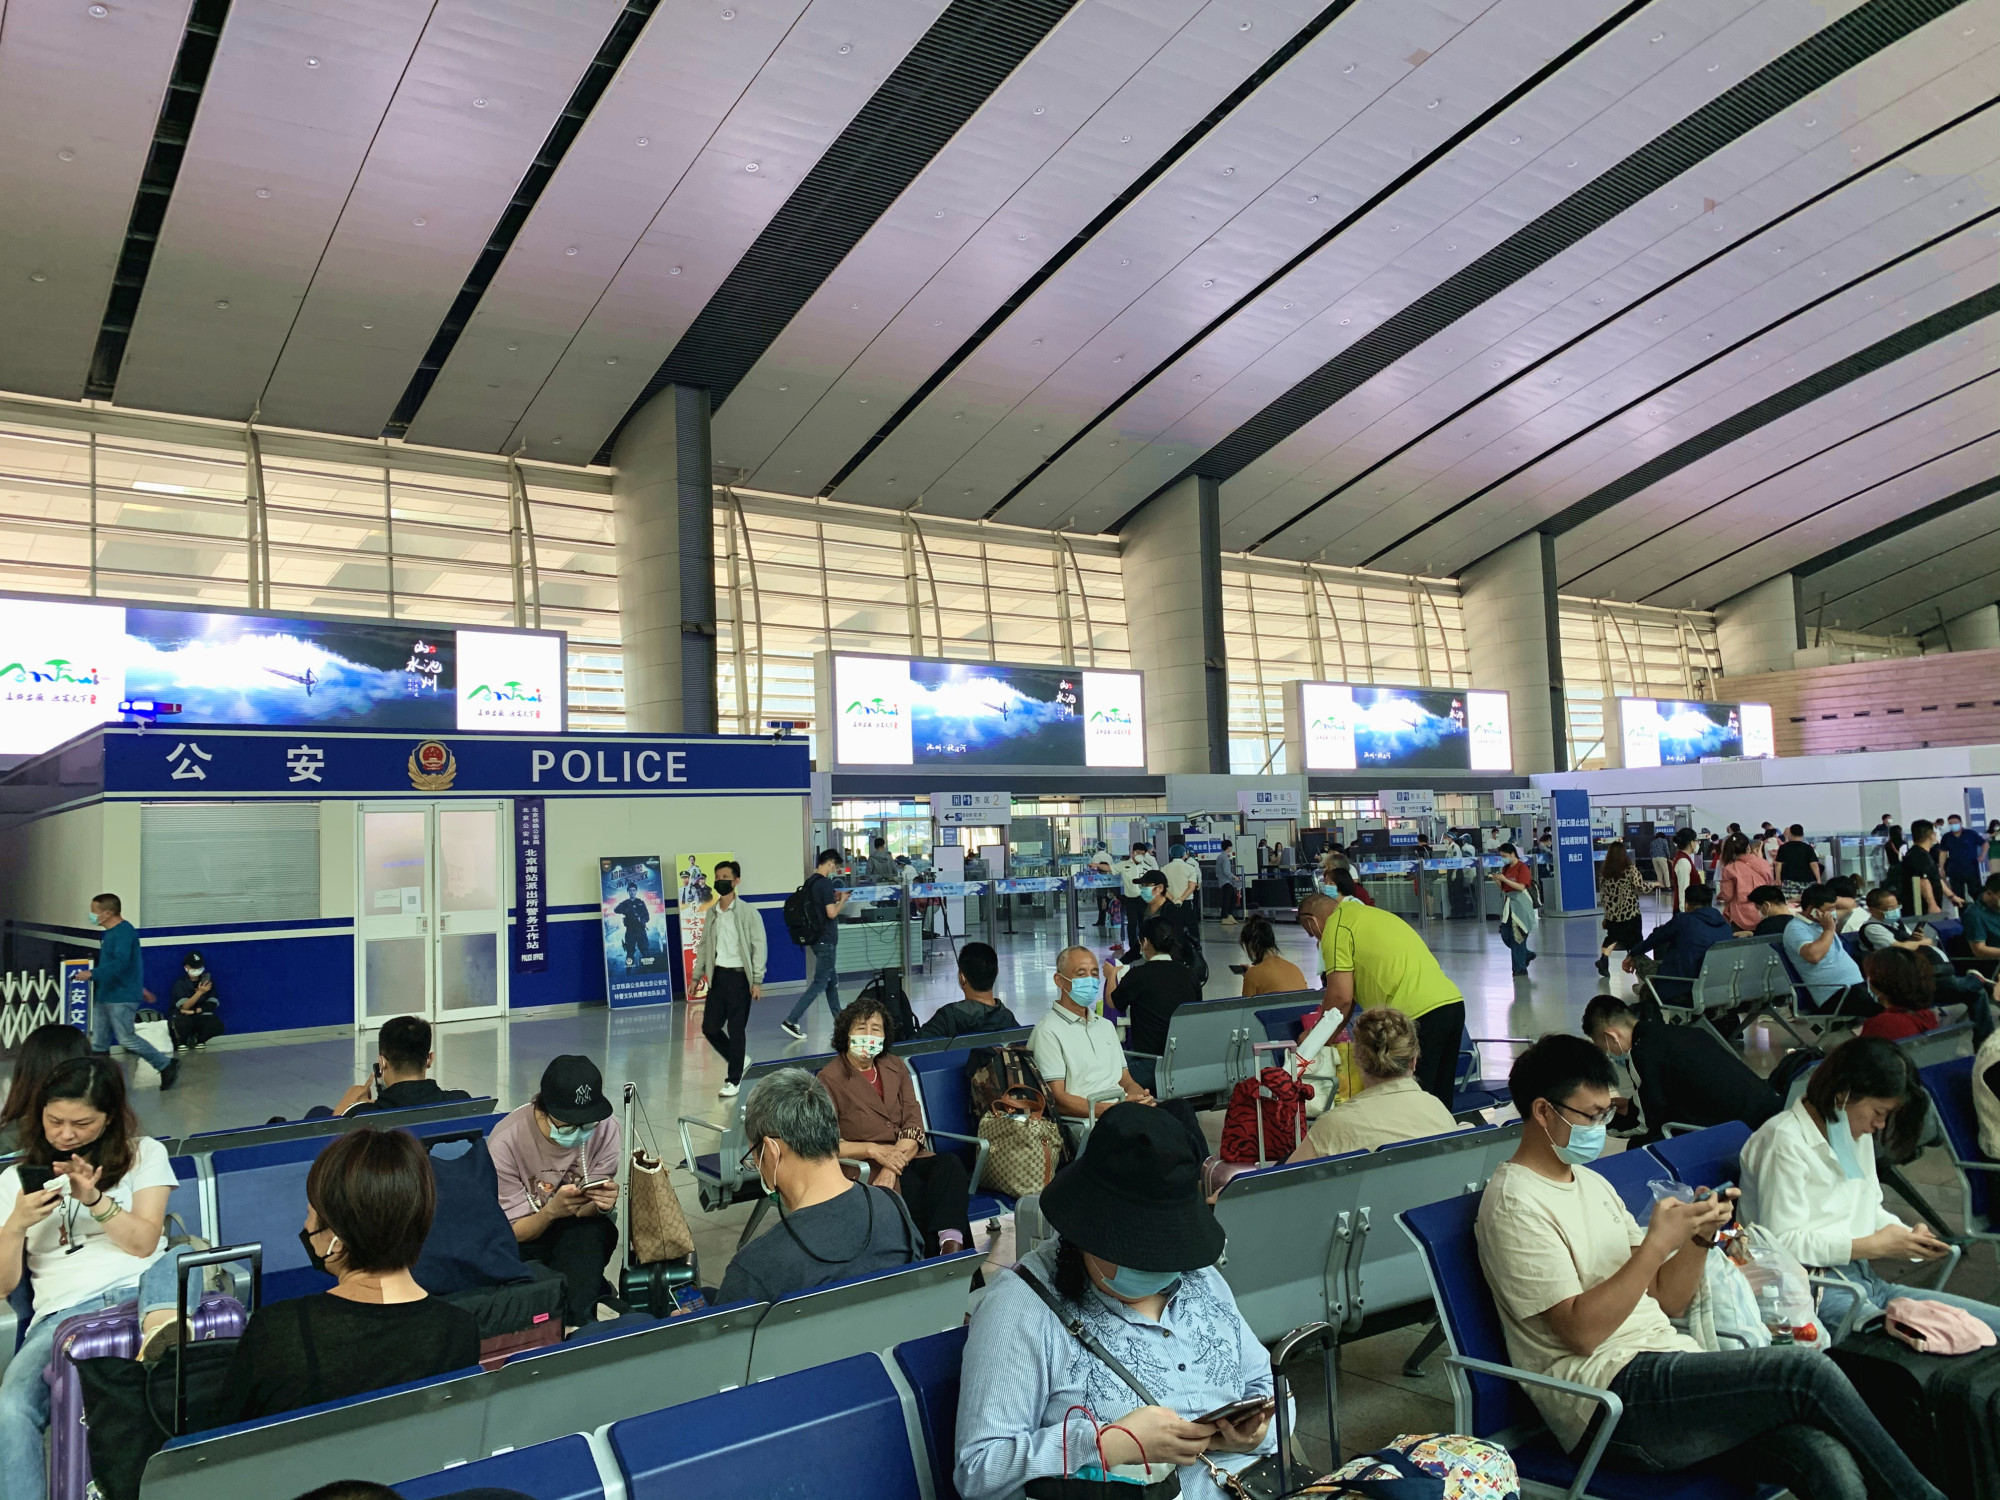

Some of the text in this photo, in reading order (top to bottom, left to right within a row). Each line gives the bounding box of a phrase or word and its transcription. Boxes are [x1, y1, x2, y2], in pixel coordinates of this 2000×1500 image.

[531, 749, 688, 783] POLICE
[525, 849, 539, 949] 北京南站派出所警务工作站
[521, 953, 544, 962] POLICE OFFICE
